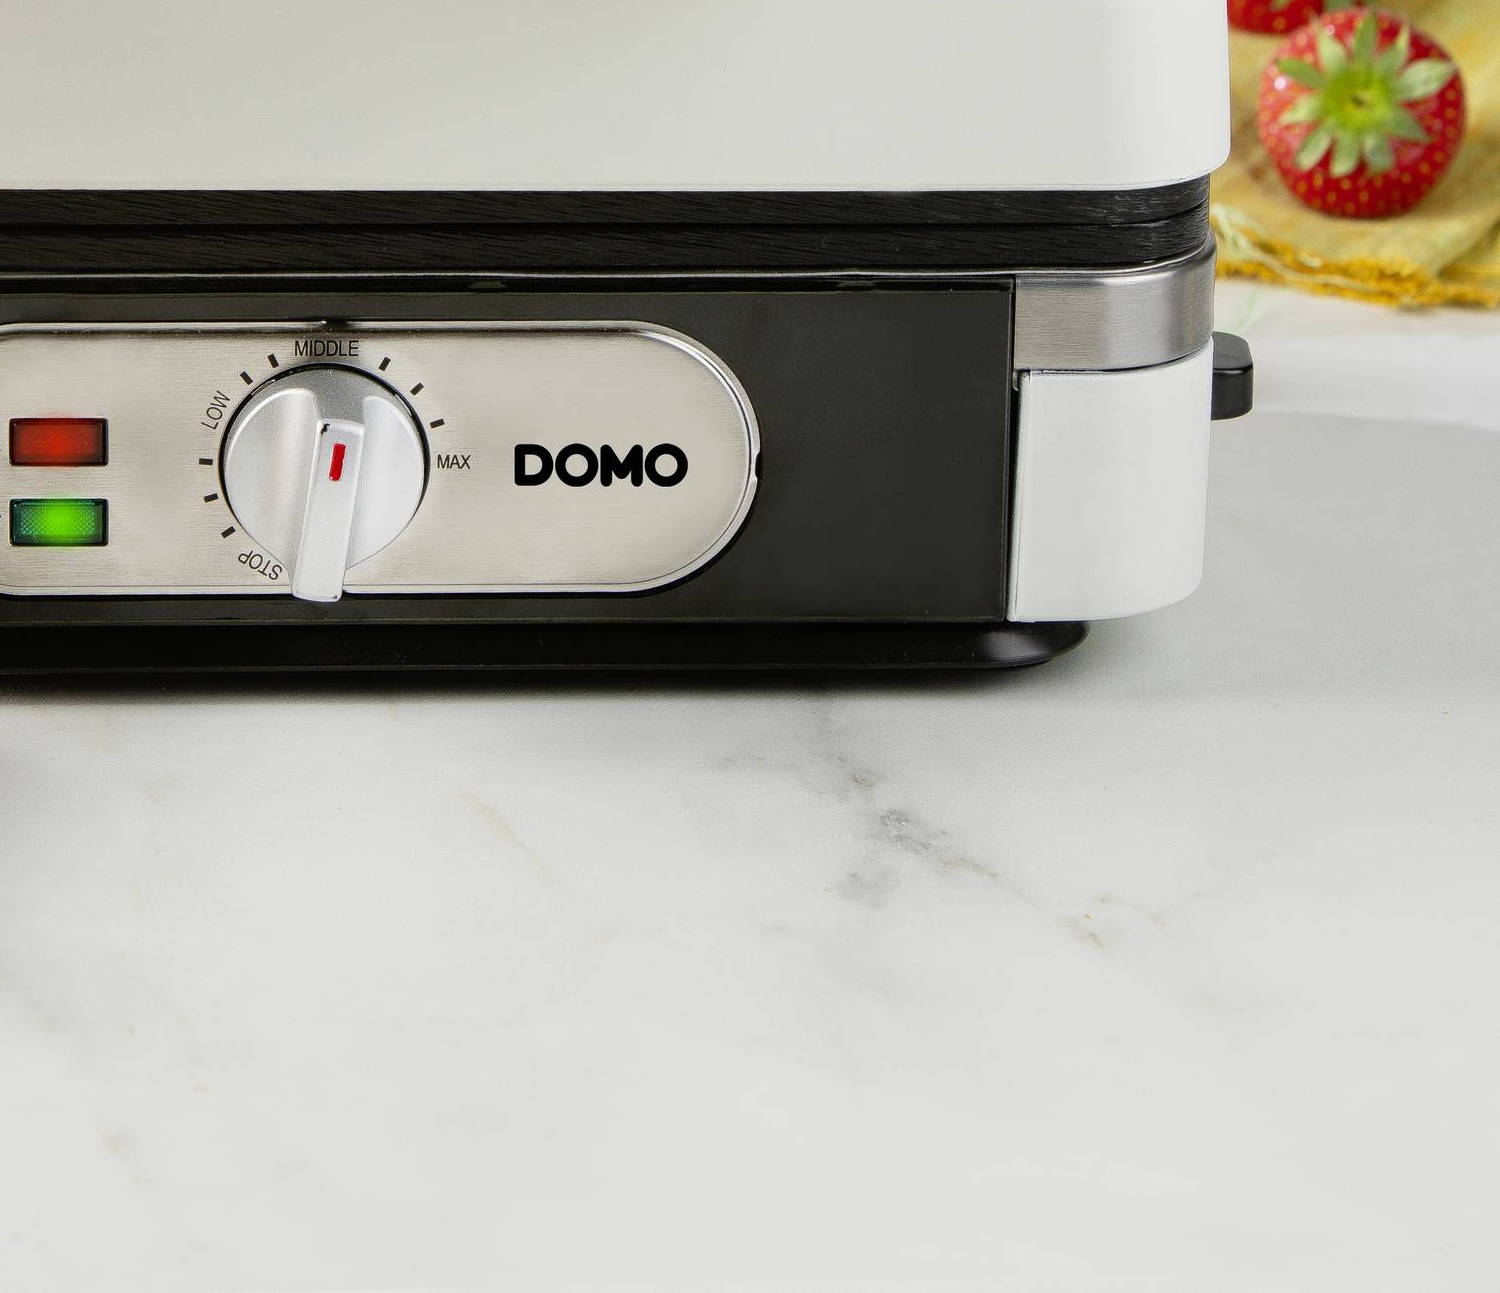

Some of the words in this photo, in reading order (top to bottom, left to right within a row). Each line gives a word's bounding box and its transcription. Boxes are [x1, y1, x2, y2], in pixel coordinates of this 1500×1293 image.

[294, 339, 360, 357] MIDDLE
[201, 391, 231, 430] LOW
[437, 454, 472, 470] MAX
[514, 443, 689, 488] DOMO
[237, 550, 283, 581] STOP
